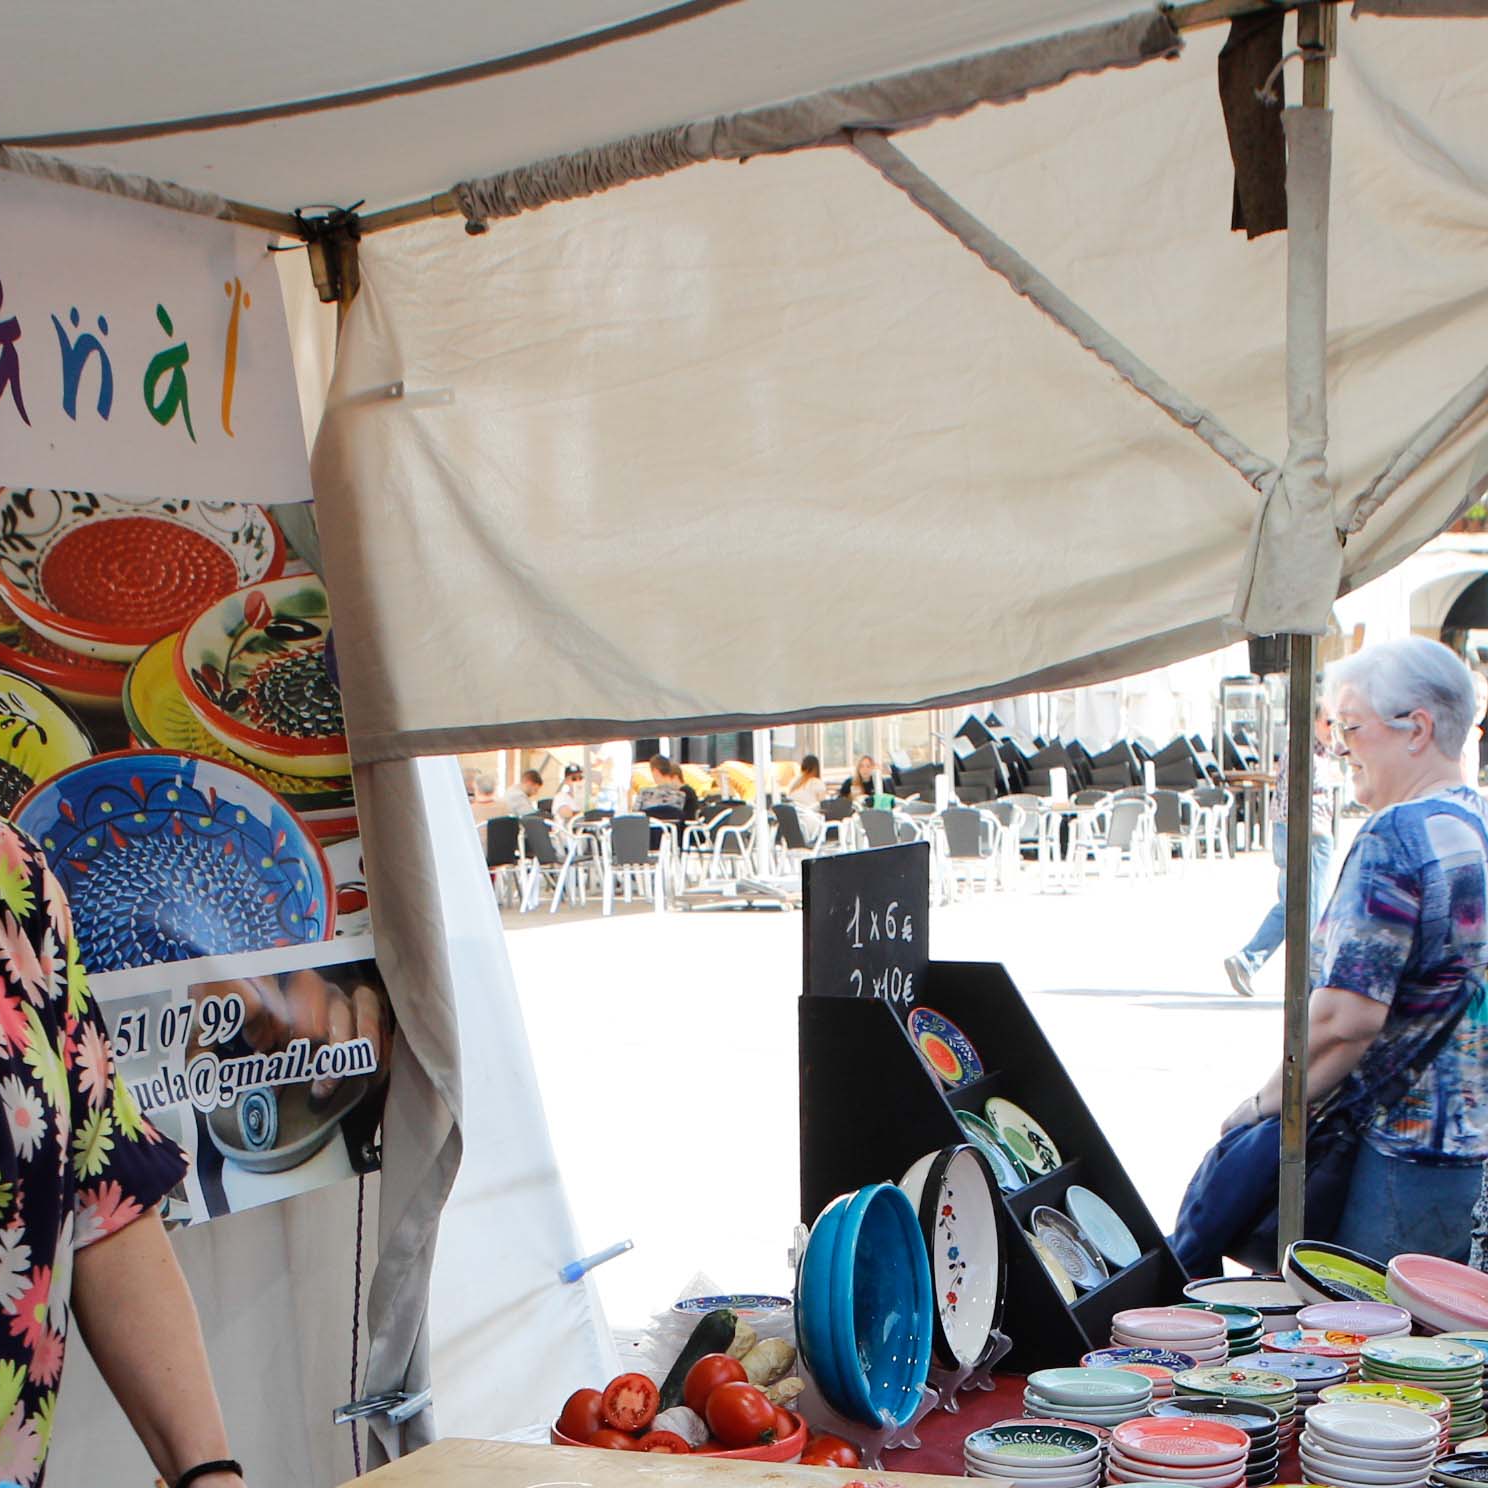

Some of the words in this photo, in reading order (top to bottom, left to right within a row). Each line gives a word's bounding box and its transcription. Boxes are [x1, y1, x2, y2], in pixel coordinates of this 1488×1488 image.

[846, 896, 864, 949] 1
[116, 1013, 147, 1056] 51
[160, 1005, 192, 1048] 07
[202, 998, 241, 1041] 99
